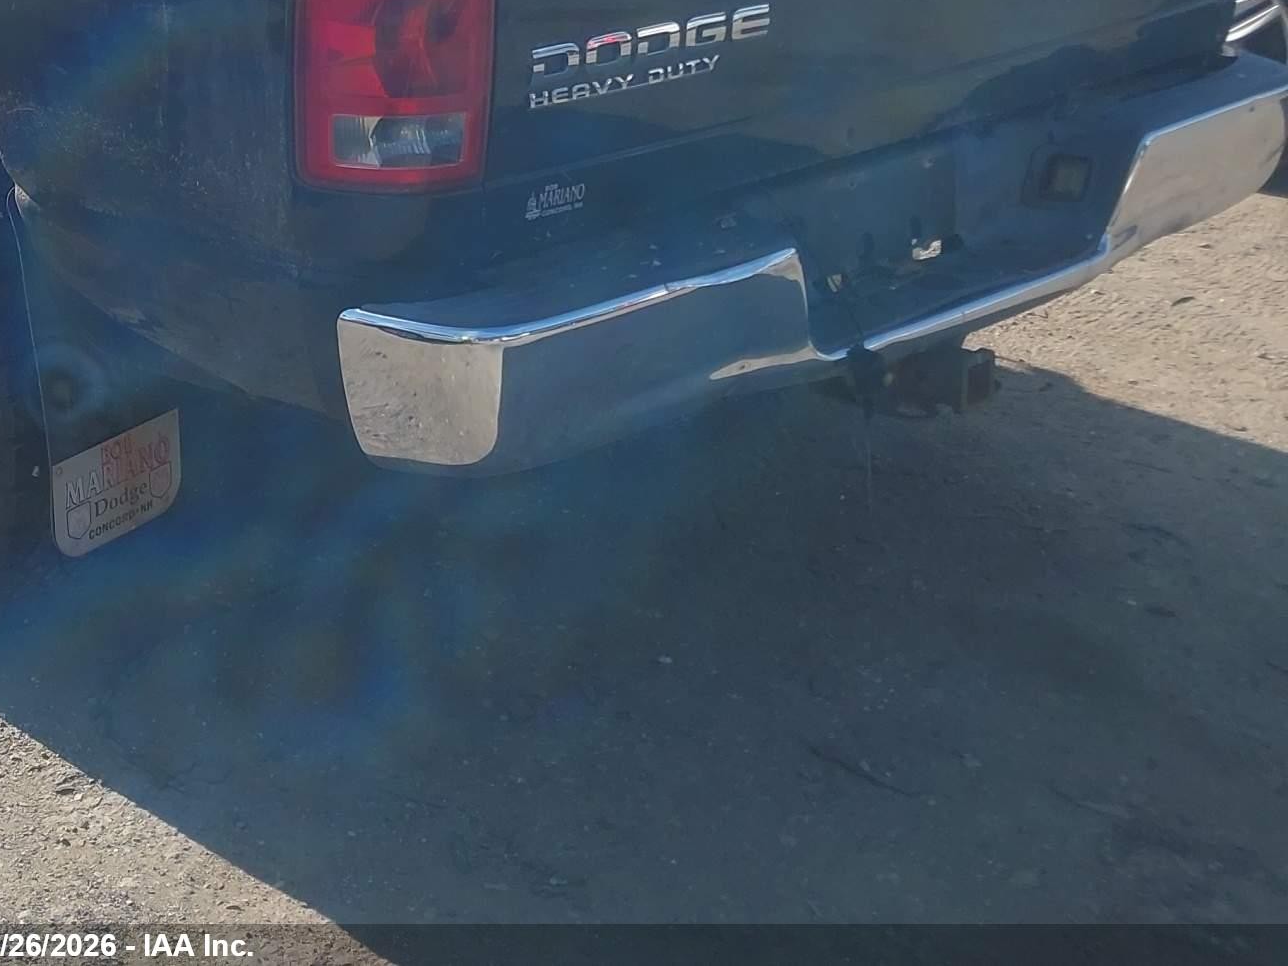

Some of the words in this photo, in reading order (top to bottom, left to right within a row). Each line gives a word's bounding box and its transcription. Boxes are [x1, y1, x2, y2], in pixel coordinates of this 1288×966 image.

[530, 3, 771, 76] DODGE
[529, 73, 634, 109] HEAVY
[648, 54, 721, 85] DUTY
[539, 183, 585, 209] MARIANO
[65, 435, 170, 510] MARIANO
[95, 482, 148, 517] Dodge
